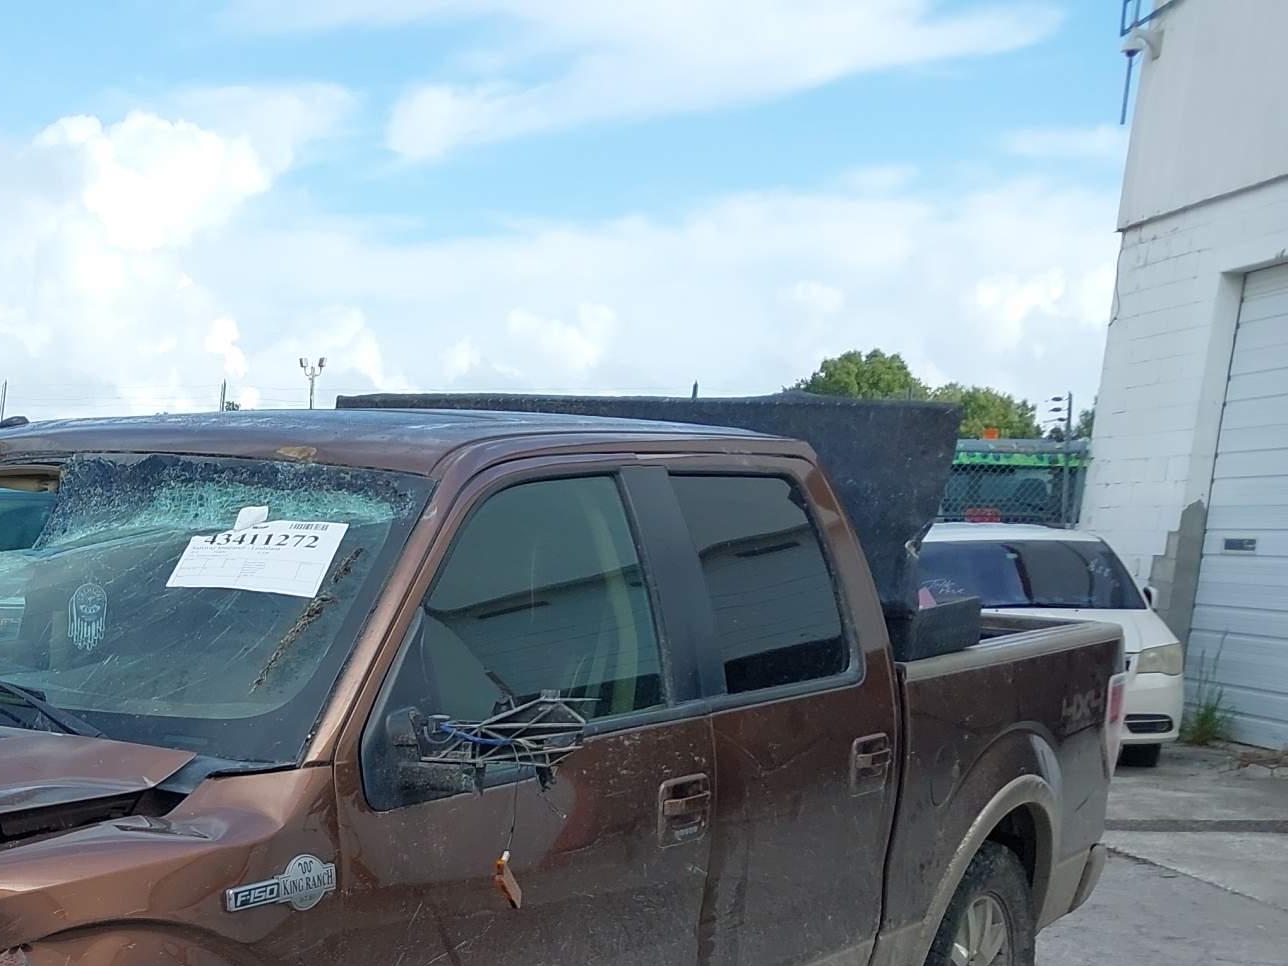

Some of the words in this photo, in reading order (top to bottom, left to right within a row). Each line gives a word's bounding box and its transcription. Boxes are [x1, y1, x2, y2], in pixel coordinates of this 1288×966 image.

[203, 532, 321, 550] 43411272
[282, 878, 305, 897] KING
[305, 868, 334, 891] RANCH
